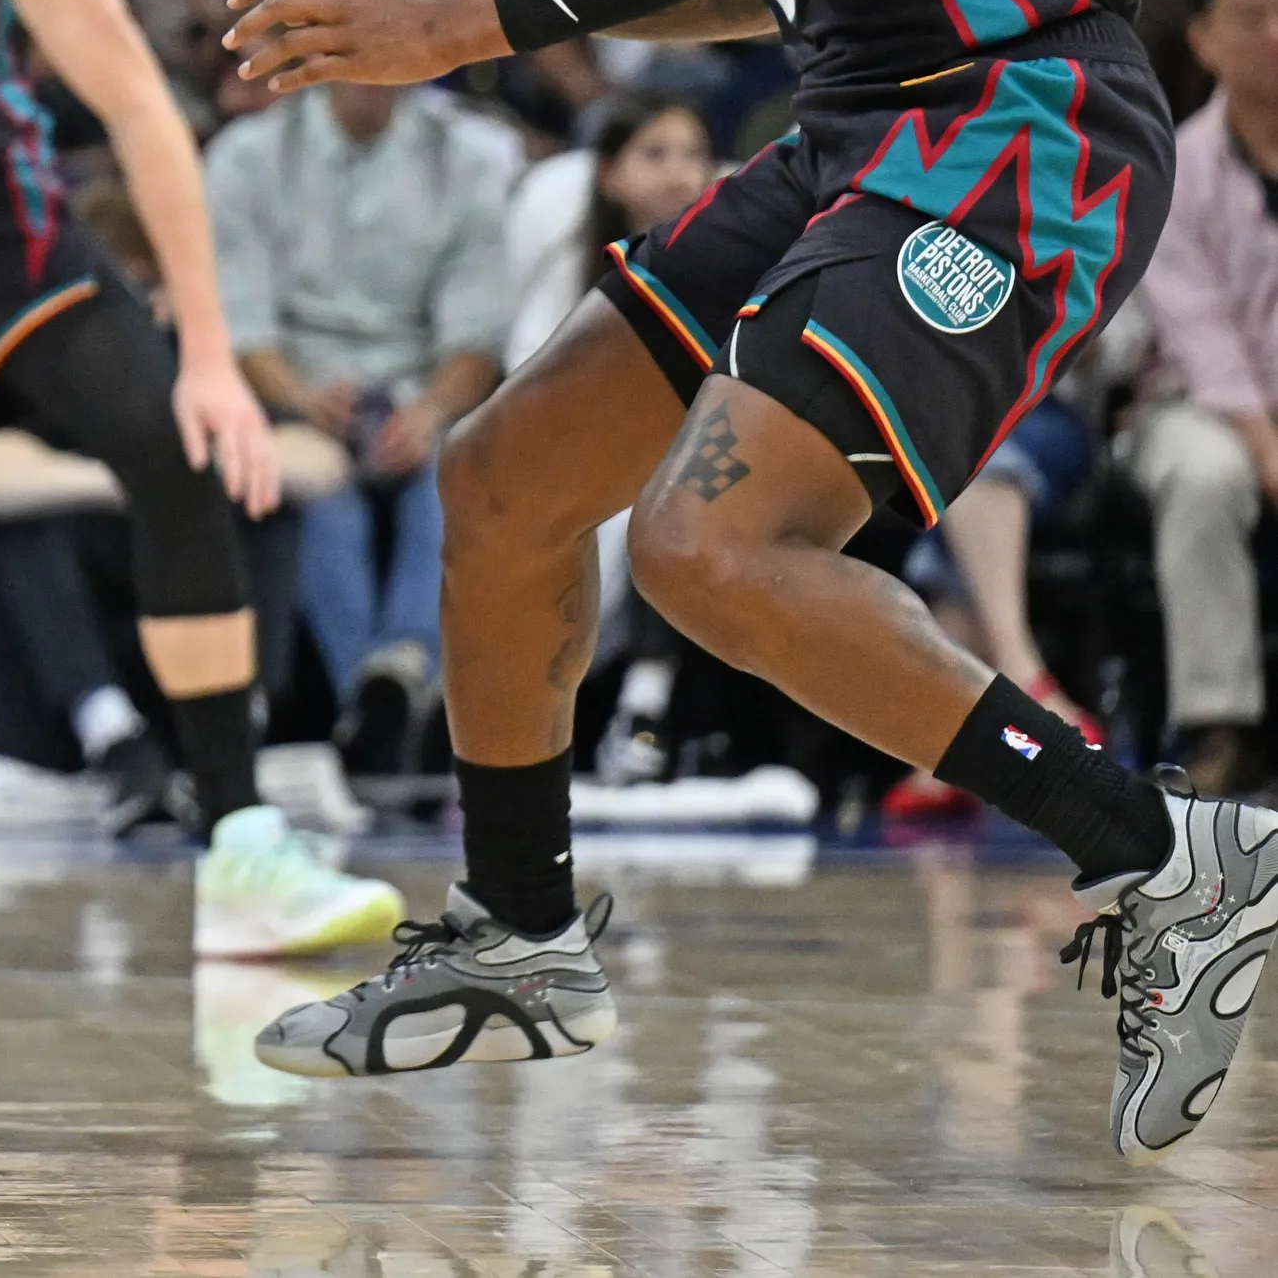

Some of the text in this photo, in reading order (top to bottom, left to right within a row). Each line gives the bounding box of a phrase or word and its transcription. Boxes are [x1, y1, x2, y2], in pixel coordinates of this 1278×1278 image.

[907, 262, 967, 324] BASKETBALL CLUB
[914, 242, 985, 316] PISTONS
[933, 226, 1006, 294] DETROIT
